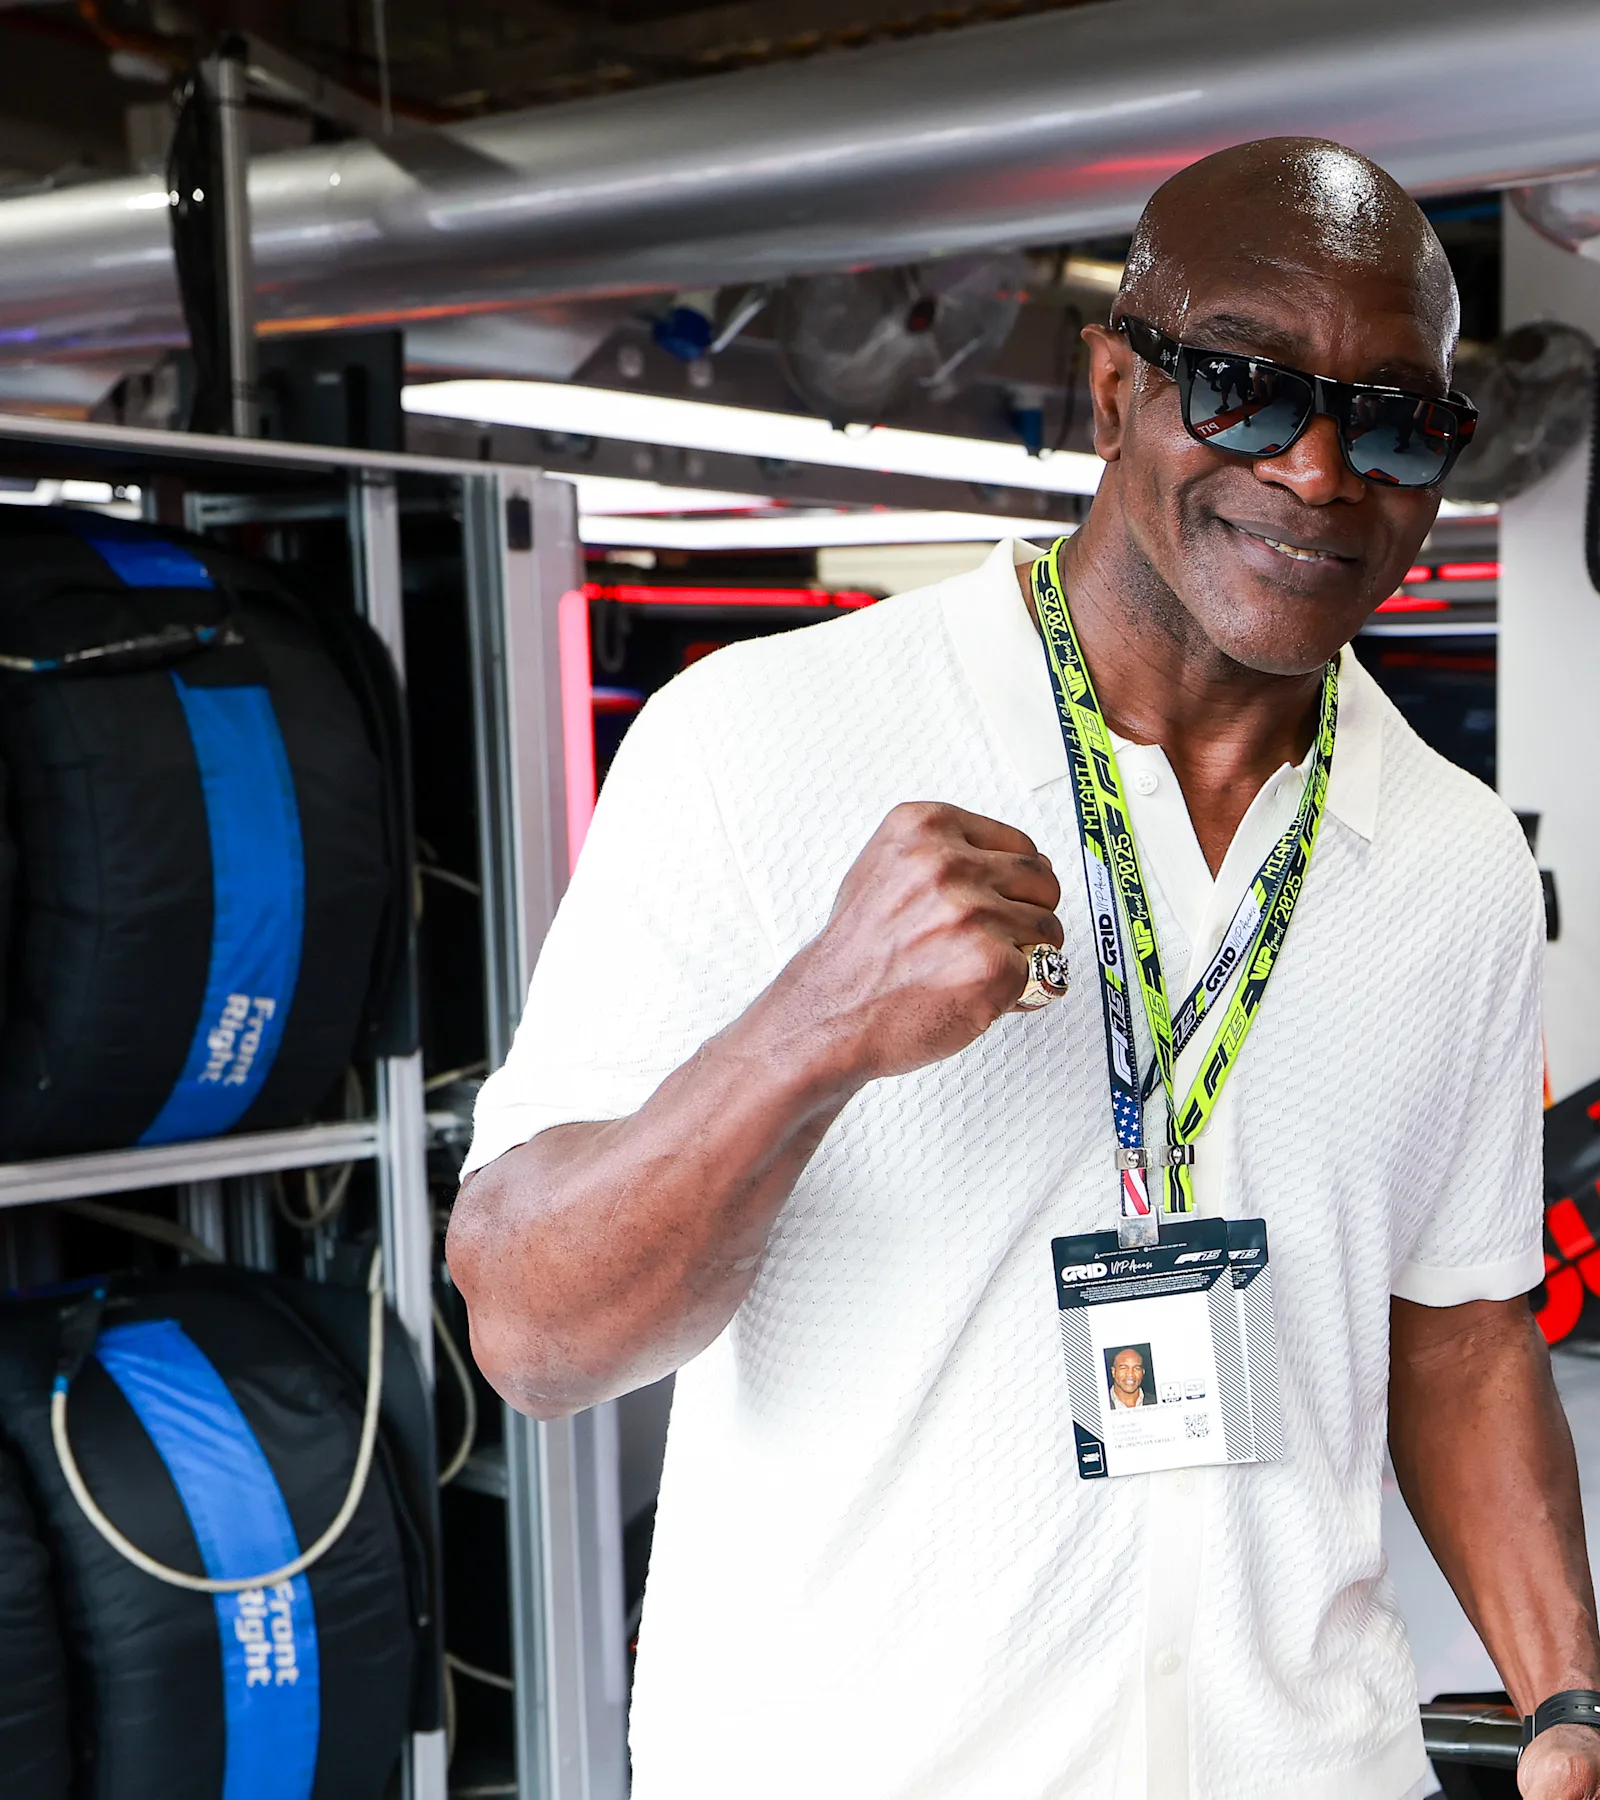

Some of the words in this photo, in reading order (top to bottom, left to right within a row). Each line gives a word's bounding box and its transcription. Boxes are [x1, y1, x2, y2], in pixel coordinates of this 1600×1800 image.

[1040, 587, 1069, 638] 2025
[1063, 665, 1088, 703] VIP
[1075, 764, 1100, 830] MIAMI
[1113, 833, 1140, 888] 2025
[1262, 825, 1300, 880] MIAMI
[1098, 914, 1117, 967] GRID
[1132, 919, 1156, 962] VIP
[1249, 946, 1274, 982] VIP
[1275, 874, 1304, 921] 2025
[1204, 946, 1237, 993] GRID
[199, 993, 250, 1086] Right
[222, 997, 275, 1088] Front
[1061, 1262, 1108, 1283] GRID
[270, 1579, 300, 1688] Front
